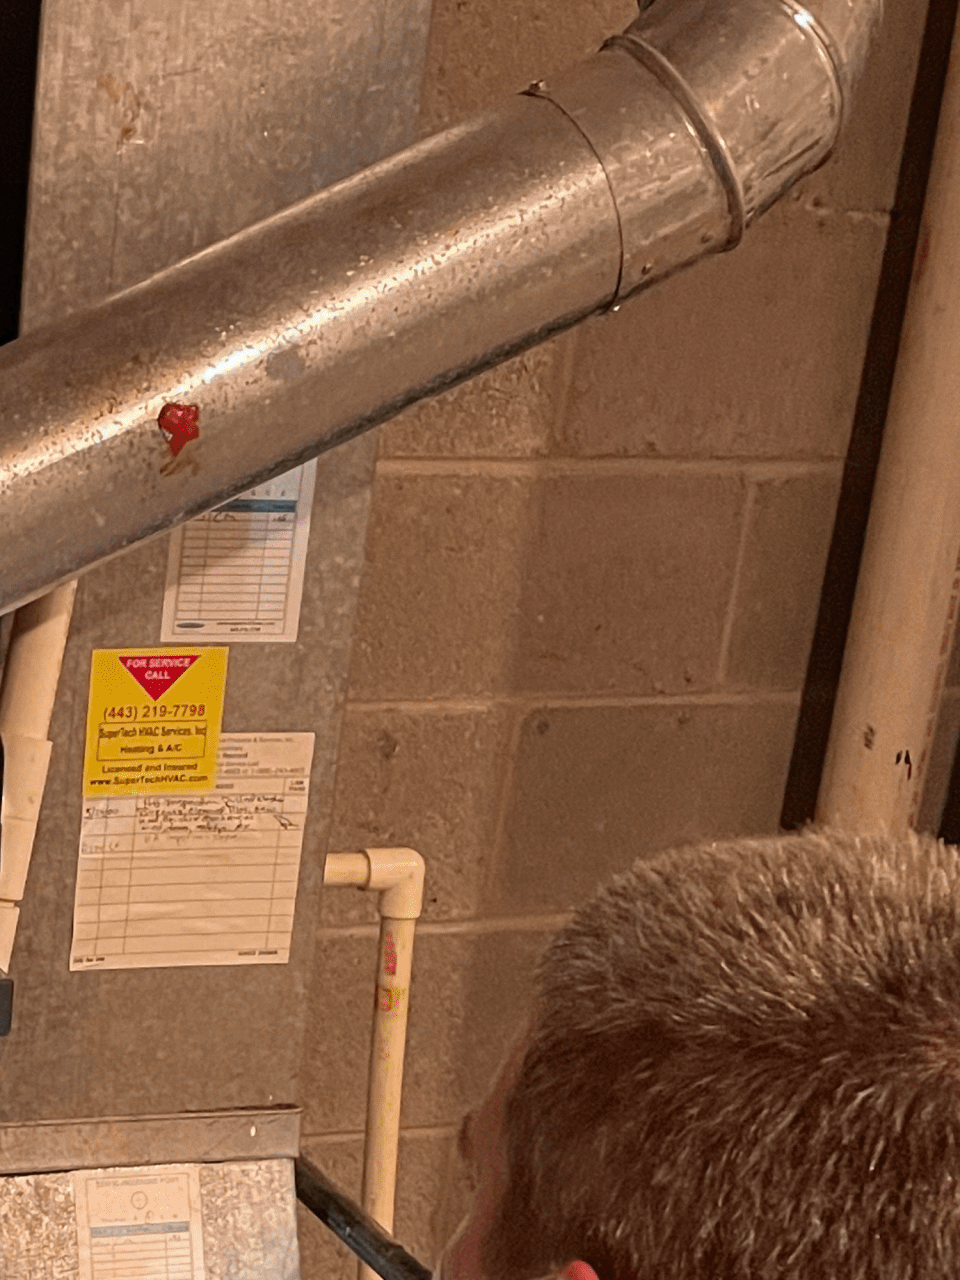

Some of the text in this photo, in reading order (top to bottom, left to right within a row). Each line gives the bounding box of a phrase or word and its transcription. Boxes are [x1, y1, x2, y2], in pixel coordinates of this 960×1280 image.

[126, 658, 191, 668] FOR SERVICE
[144, 670, 171, 680] CALL
[103, 704, 206, 721] (443) 219-7798
[99, 726, 137, 740] SuperTech
[138, 726, 160, 737] HVAC
[120, 745, 155, 754] Heating
[157, 744, 164, 752] &
[102, 763, 198, 773] Licensed and Insured
[90, 774, 208, 786] www.SuperTechHVAC.com
